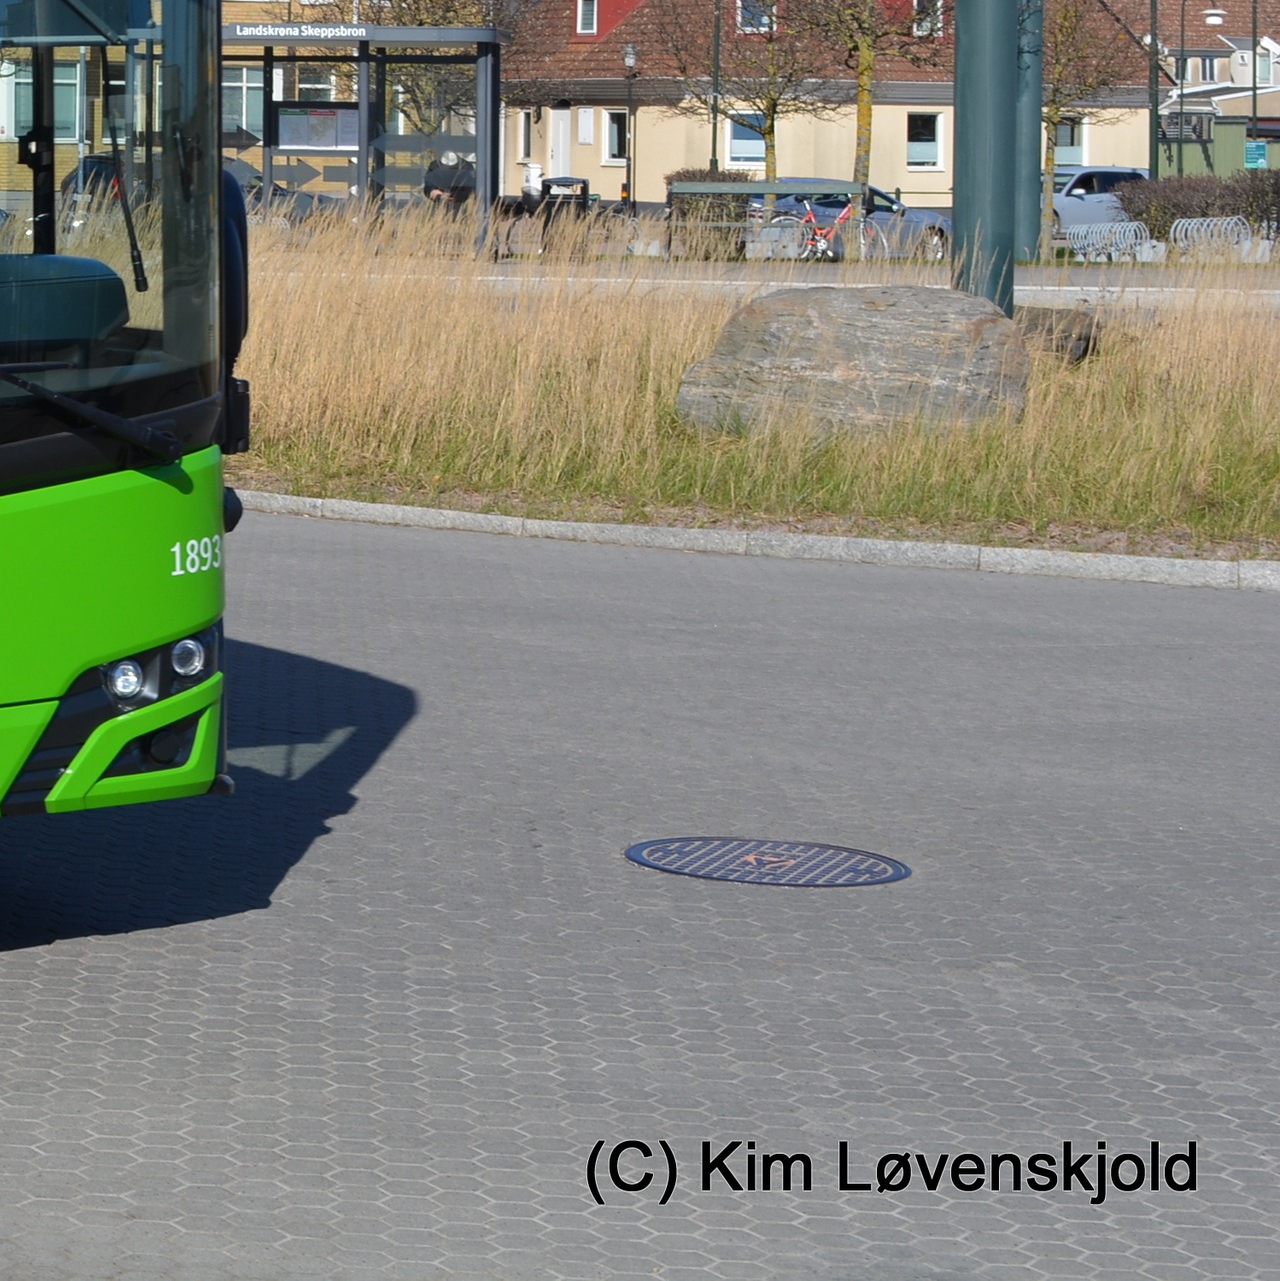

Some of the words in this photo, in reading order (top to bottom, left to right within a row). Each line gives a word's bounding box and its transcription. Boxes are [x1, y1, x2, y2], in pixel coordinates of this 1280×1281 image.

[236, 24, 300, 36] Landskrona
[300, 25, 367, 39] Skeppsbron
[170, 534, 222, 576] 1893
